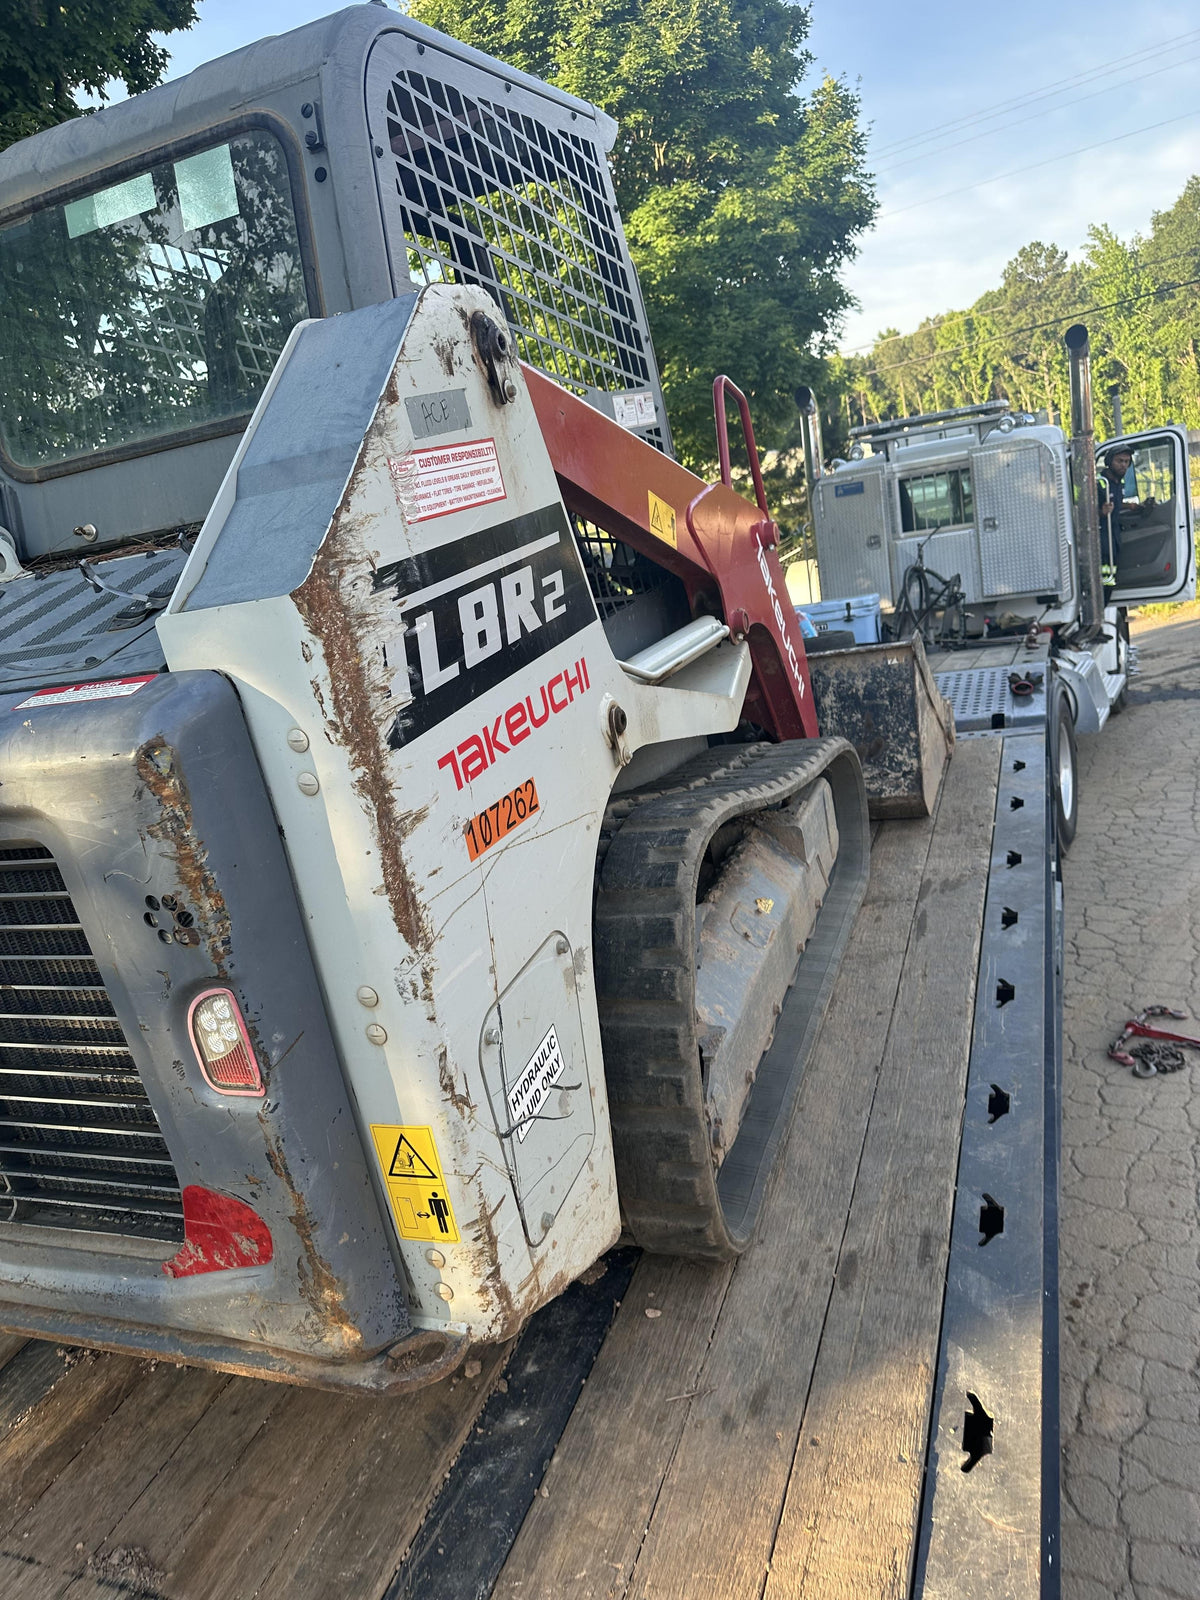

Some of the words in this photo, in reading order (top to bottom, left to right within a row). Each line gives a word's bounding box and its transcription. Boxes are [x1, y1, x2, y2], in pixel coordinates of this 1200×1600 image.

[421, 399, 449, 432] ACE
[418, 454, 451, 468] CUSTOMER
[451, 447, 494, 461] RESPONSIBILITY
[467, 779, 538, 854] 107262
[511, 1035, 557, 1112] HYDRAULIC
[541, 1053, 561, 1091] ONLY
